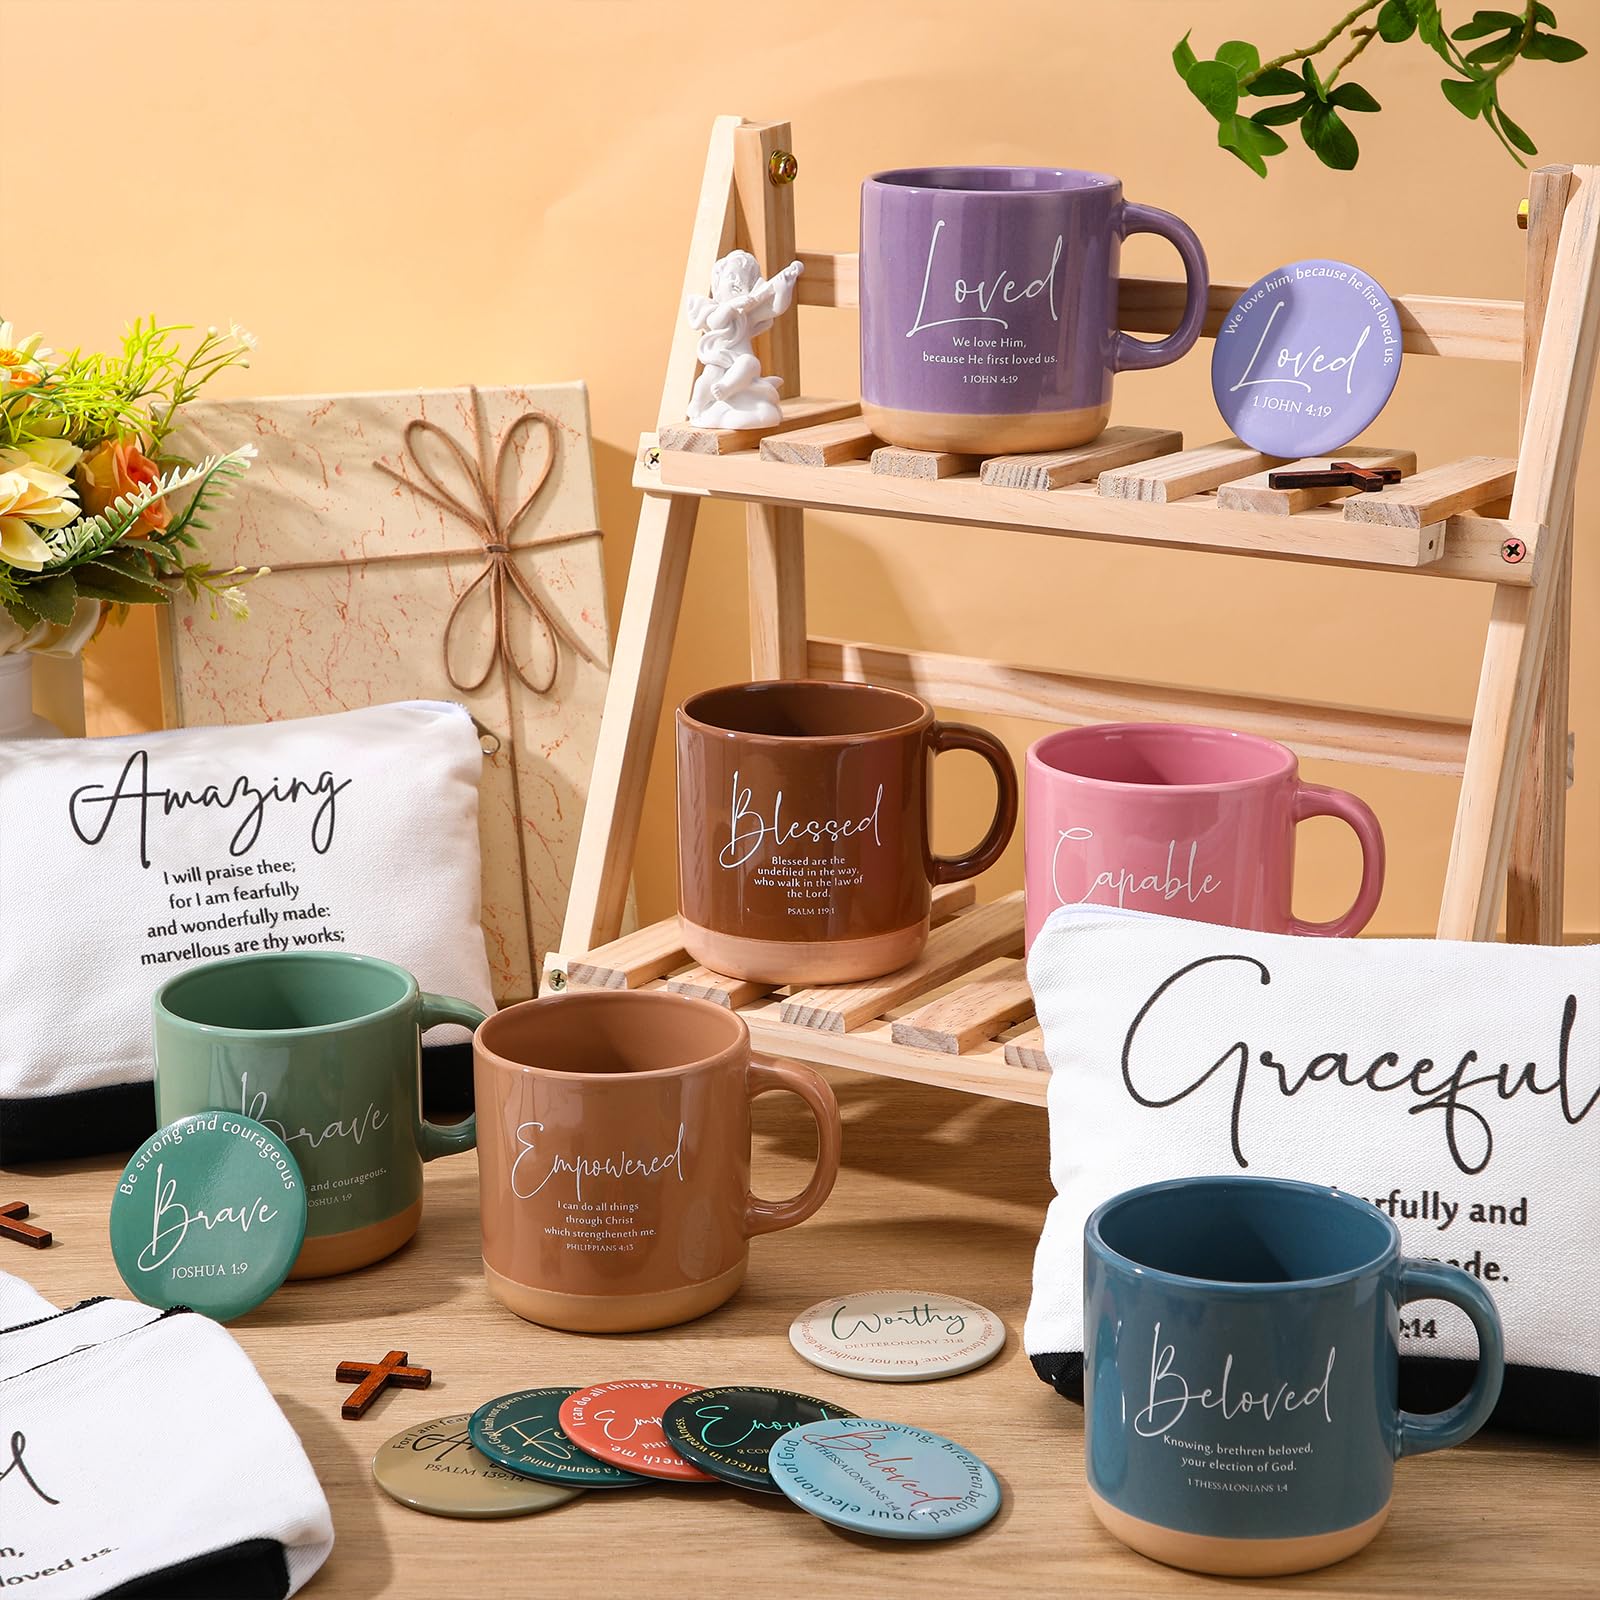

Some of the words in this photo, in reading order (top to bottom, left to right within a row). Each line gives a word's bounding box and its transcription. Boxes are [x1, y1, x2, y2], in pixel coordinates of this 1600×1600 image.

[906, 219, 1064, 338] Loved
[1265, 274, 1294, 293] him,
[1296, 267, 1348, 281] because
[1348, 273, 1363, 290] he
[1239, 289, 1266, 313] love
[1362, 285, 1382, 310] first
[1225, 315, 1243, 334] We
[1376, 307, 1398, 345] loved
[952, 336, 970, 347] We
[974, 336, 996, 348] love
[1000, 337, 1026, 348] Him,
[1230, 301, 1371, 394] Loved
[923, 351, 964, 364] because
[968, 355, 983, 365] He
[987, 354, 1008, 365] first
[1012, 354, 1040, 365] loved
[1044, 355, 1058, 363] us.
[1383, 347, 1393, 367] us.
[963, 375, 967, 383] 1
[970, 375, 997, 383] JOHN
[1000, 375, 1018, 384] 4:19
[1253, 396, 1259, 406] 1
[1262, 397, 1302, 413] JOHN
[1305, 405, 1332, 417] 4:19
[69, 750, 352, 869] Amazing
[719, 771, 883, 868] Blessed
[772, 856, 809, 866] Blessed
[811, 858, 827, 866] are
[830, 856, 846, 865] the
[1052, 827, 1222, 908] Capable
[163, 872, 170, 885] I
[172, 867, 203, 884] will
[206, 865, 253, 885] praise
[257, 859, 297, 876] thee;
[754, 877, 775, 887] who
[777, 879, 801, 887] walk
[804, 879, 813, 887] in
[816, 879, 832, 887] the
[834, 877, 852, 887] law
[854, 875, 864, 884] of
[758, 868, 804, 877] undefiled
[807, 868, 816, 876] in
[820, 868, 835, 876] the
[169, 894, 192, 909] for
[196, 892, 202, 907] I
[205, 892, 230, 906] am
[233, 881, 300, 902] fearfully
[787, 890, 803, 898] the
[147, 920, 178, 938] and
[181, 908, 279, 934] wonderfully
[282, 903, 331, 922] made:
[140, 943, 231, 966] marvellous
[234, 939, 259, 953] are
[263, 932, 289, 952] thy
[292, 926, 346, 946] works;
[1121, 955, 1600, 1175] Graceful
[119, 1174, 138, 1196] Be
[136, 1127, 183, 1171] strong
[186, 1115, 217, 1134] and
[222, 1121, 295, 1190] courageous
[511, 1122, 685, 1202] Empowered
[310, 1180, 329, 1192] and
[306, 1196, 340, 1208] OSHUA
[563, 1202, 579, 1210] can
[581, 1202, 593, 1211] do
[595, 1202, 607, 1211] all
[609, 1202, 639, 1213] things
[1469, 1197, 1528, 1226] and
[137, 1163, 278, 1272] Brave
[566, 1216, 602, 1227] through
[605, 1216, 633, 1225] Christ
[544, 1227, 571, 1237] which
[572, 1229, 638, 1241] strengtheneth
[171, 1265, 225, 1280] JOSHUA
[231, 1262, 248, 1275] 1:9
[832, 1304, 968, 1340] Worthy
[607, 1382, 658, 1391] things
[1134, 1322, 1336, 1437] Beloved
[573, 1396, 591, 1406] do
[590, 1388, 607, 1398] all
[683, 1395, 704, 1405] My
[703, 1388, 736, 1399] grace
[573, 1407, 584, 1421] can
[392, 1436, 411, 1450] For
[419, 1423, 438, 1434] am
[839, 1419, 935, 1445] Knowing,
[1163, 1435, 1214, 1456] Knowing,
[1217, 1444, 1265, 1457] brethren
[424, 1463, 477, 1476] PSALM
[557, 1463, 600, 1473] sound
[725, 1456, 768, 1475] erfect
[776, 1461, 799, 1474] of
[802, 1429, 963, 1507] Beloved
[941, 1442, 983, 1489] brethren
[1181, 1456, 1205, 1468] your
[1209, 1460, 1254, 1472] election
[1257, 1461, 1269, 1472] of
[1271, 1461, 1297, 1471] God.
[793, 1476, 861, 1513] election
[1194, 1479, 1274, 1493] THESSALONIANS
[867, 1509, 918, 1522] your
